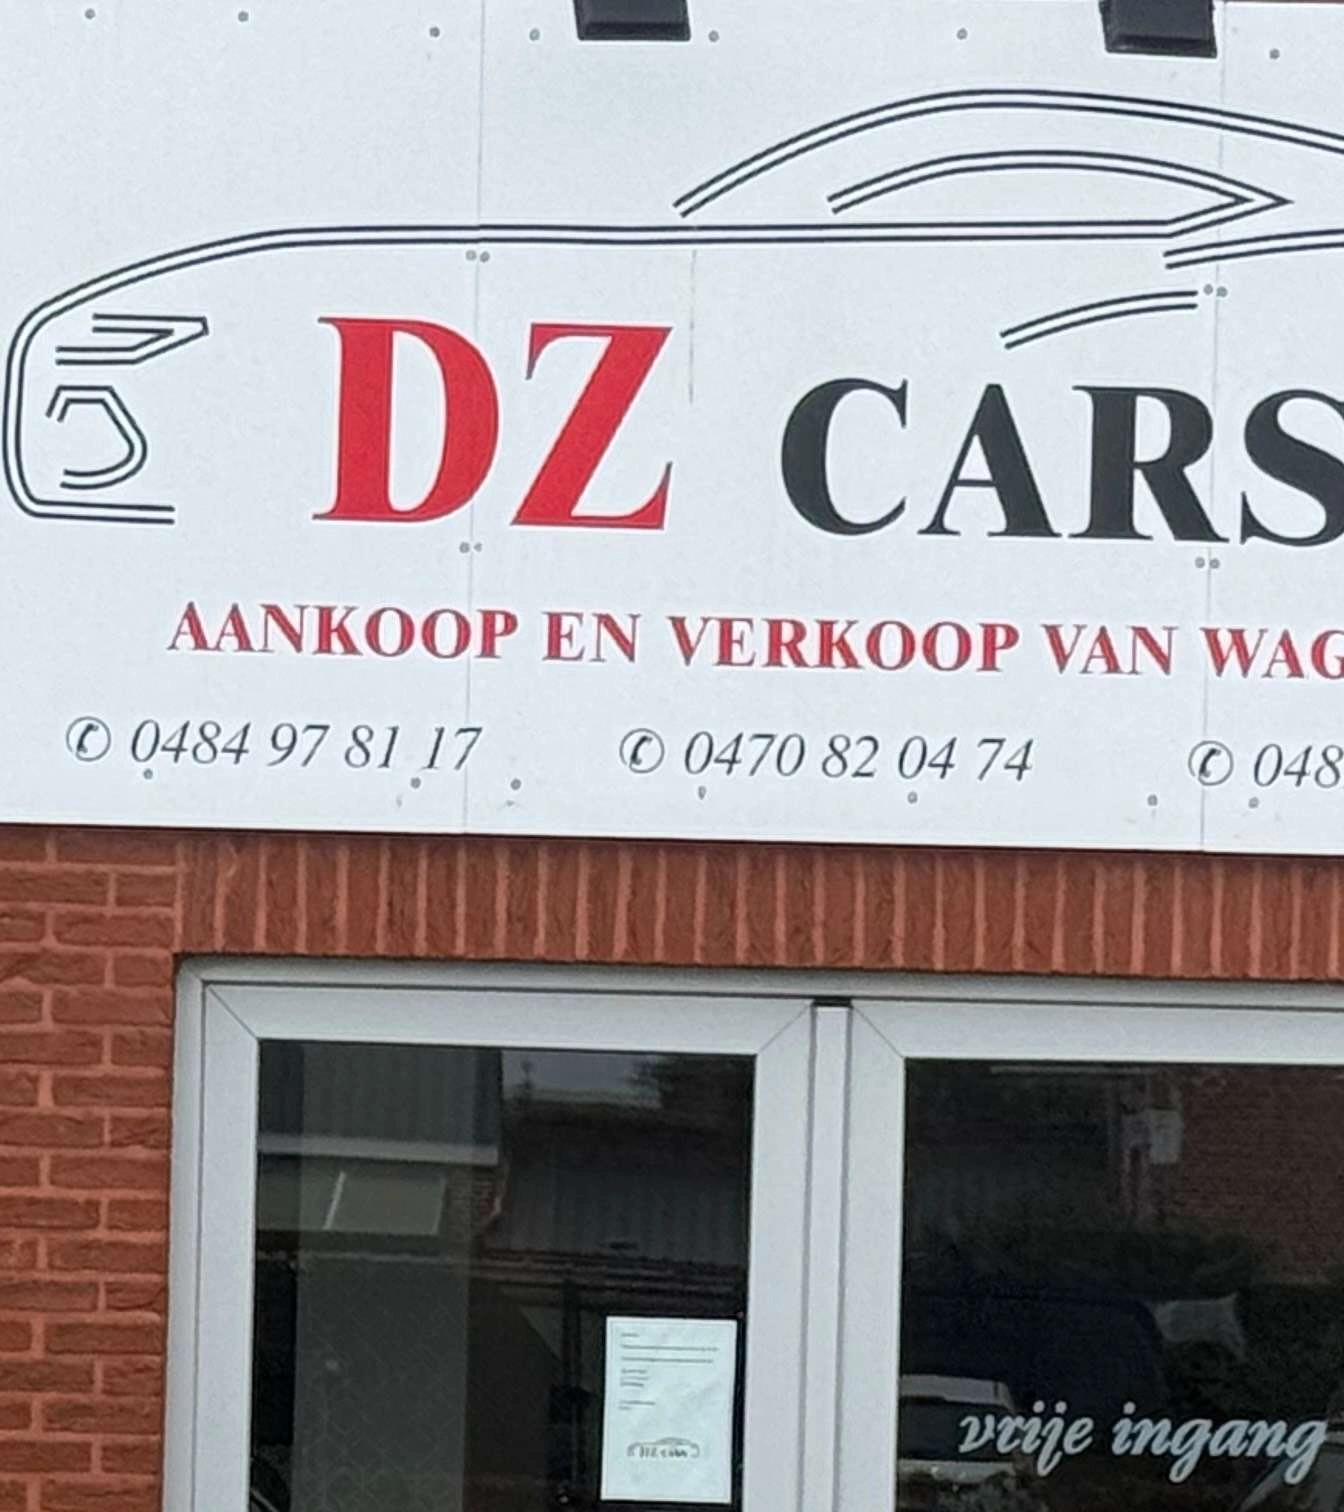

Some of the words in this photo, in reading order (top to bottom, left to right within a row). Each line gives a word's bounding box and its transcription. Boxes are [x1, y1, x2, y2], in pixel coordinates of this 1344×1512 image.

[312, 316, 673, 530] DZ
[166, 601, 519, 660] AANKOOP
[541, 611, 643, 664] EN
[665, 614, 1019, 673] VERKOOP
[1040, 623, 1178, 676] VAN
[130, 718, 252, 766] 0484
[265, 722, 330, 768] 97
[343, 724, 400, 769] 81
[419, 726, 483, 771] 17
[683, 730, 807, 777] 0470
[820, 734, 879, 778] 82
[897, 735, 959, 780] 04
[975, 738, 1036, 782] 74
[958, 1400, 1095, 1478] vrije
[1111, 1401, 1329, 1486] ingang
